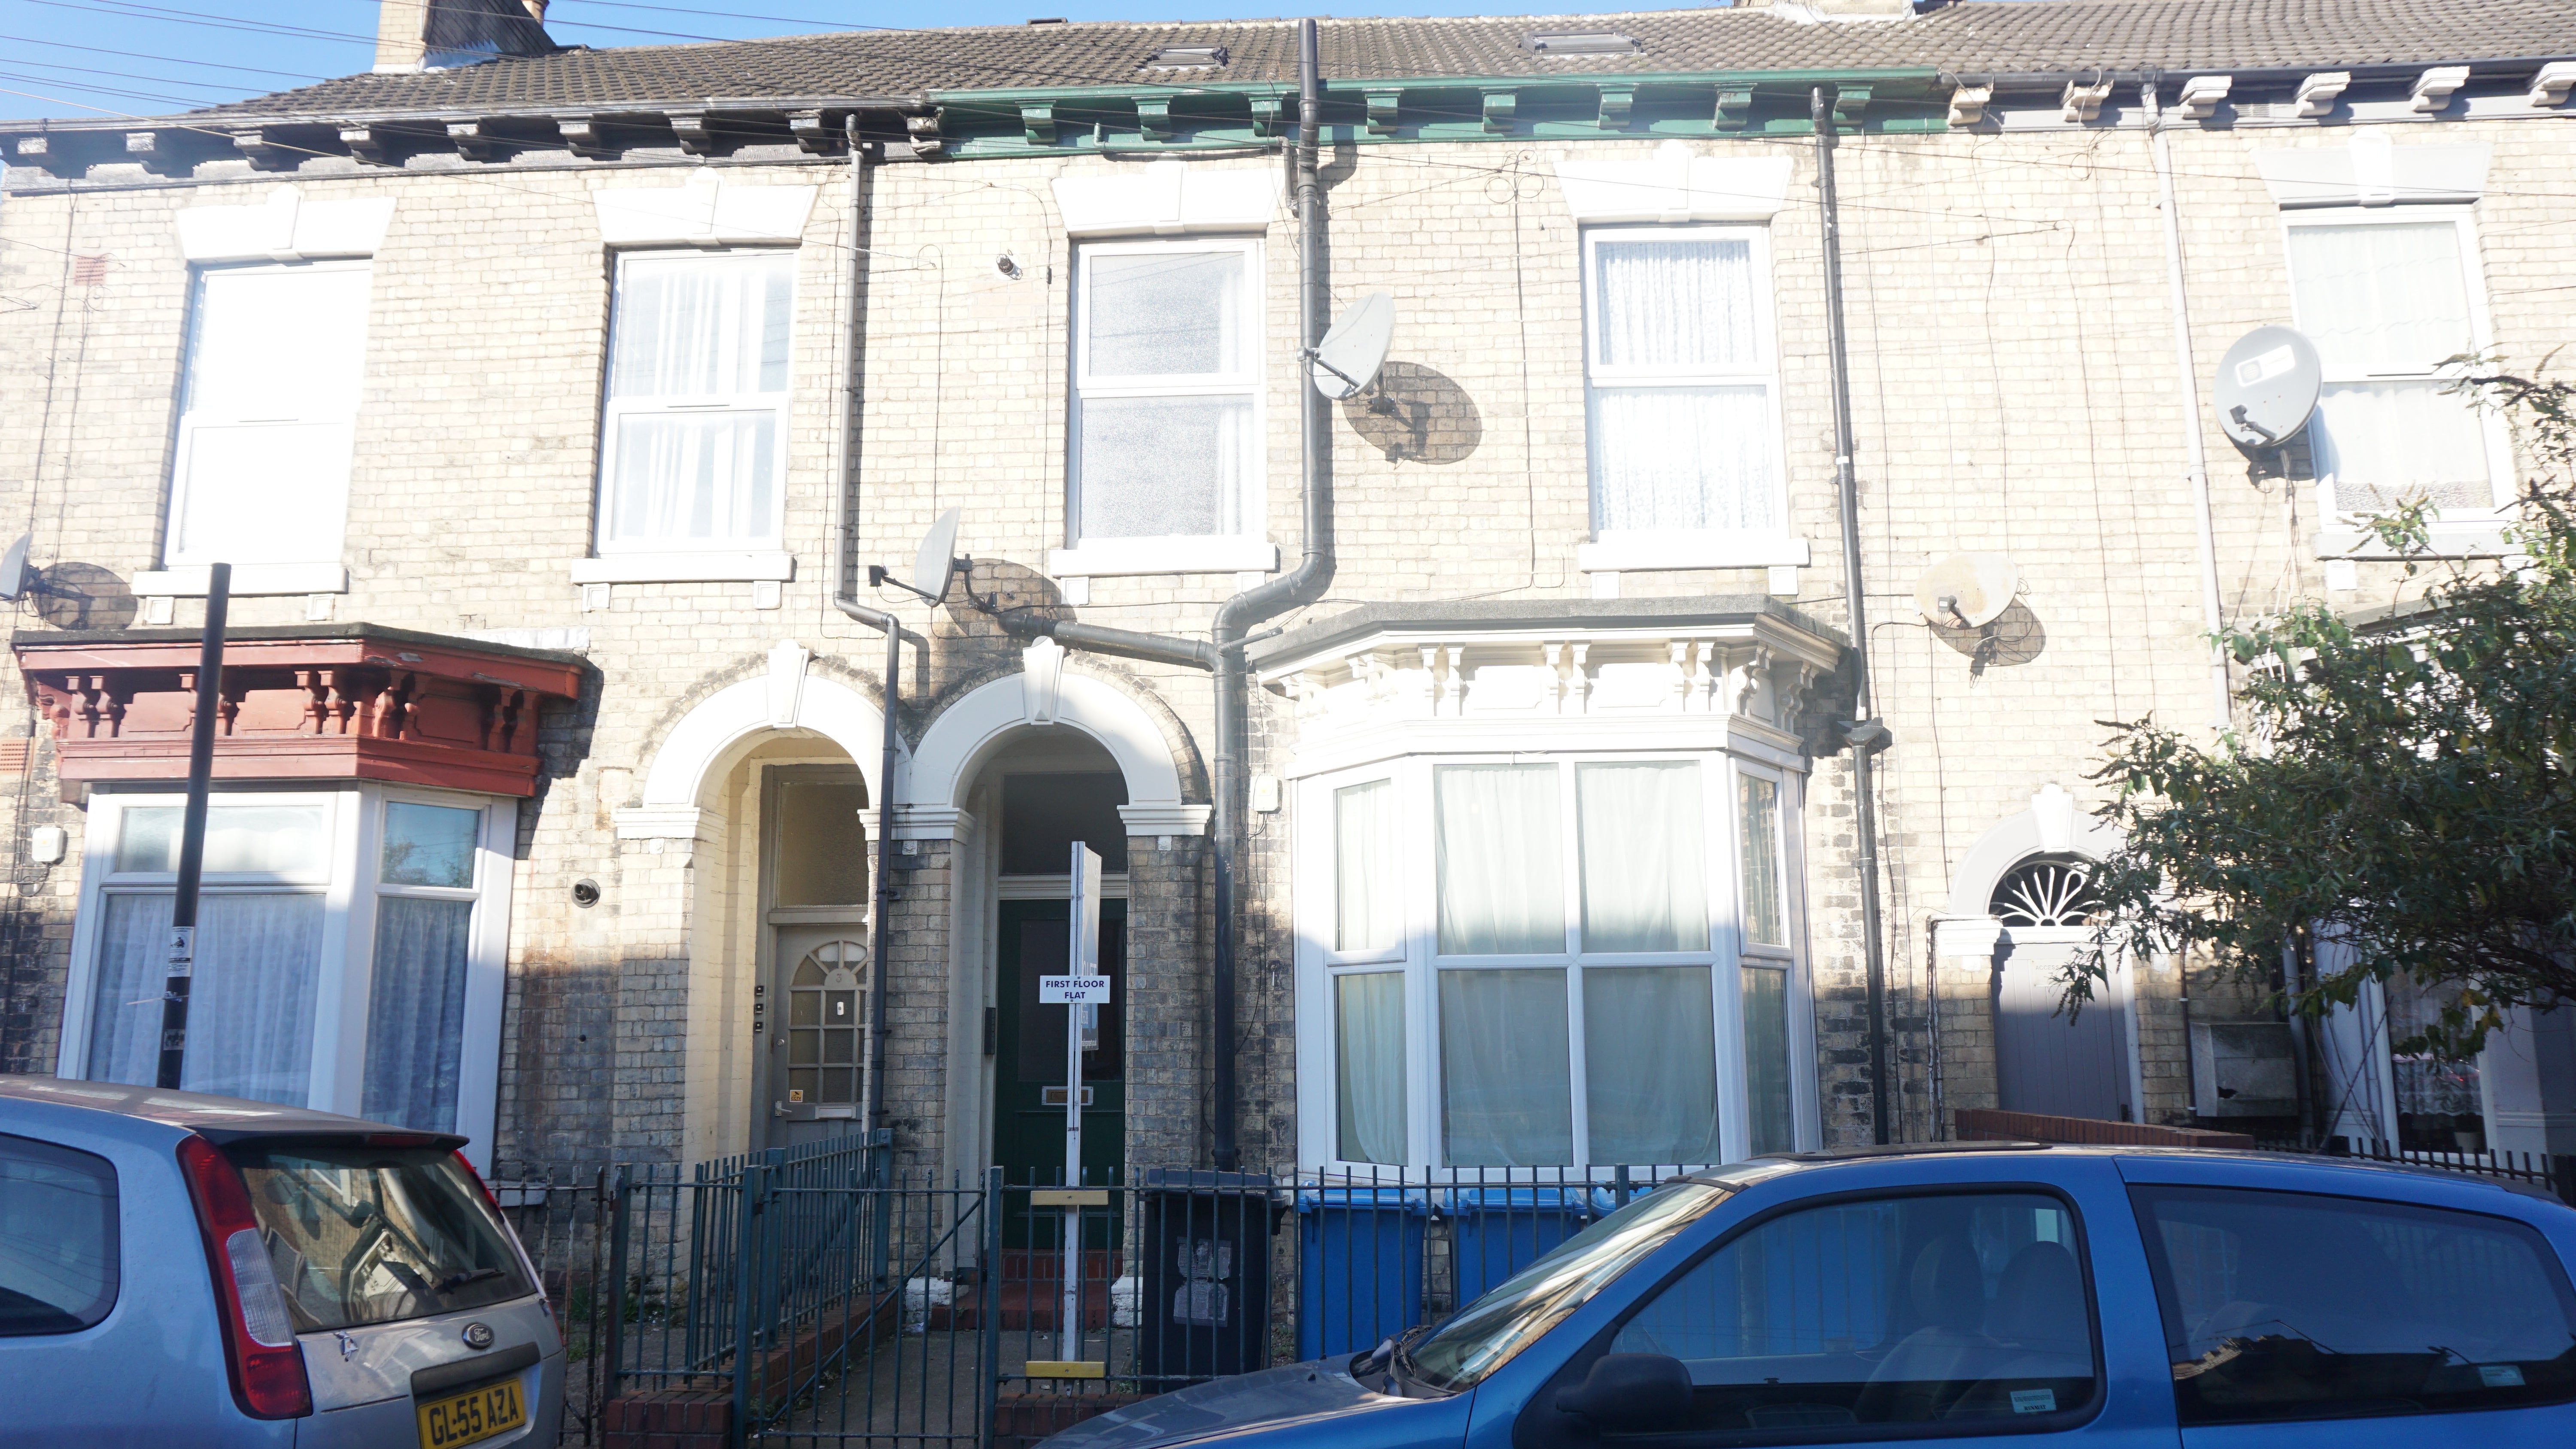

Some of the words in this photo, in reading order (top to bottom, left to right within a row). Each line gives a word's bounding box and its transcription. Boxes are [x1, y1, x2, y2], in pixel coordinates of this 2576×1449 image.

[474, 1328, 489, 1342] Ford
[430, 1396, 482, 1446] GL55
[486, 1386, 519, 1428] AZA
